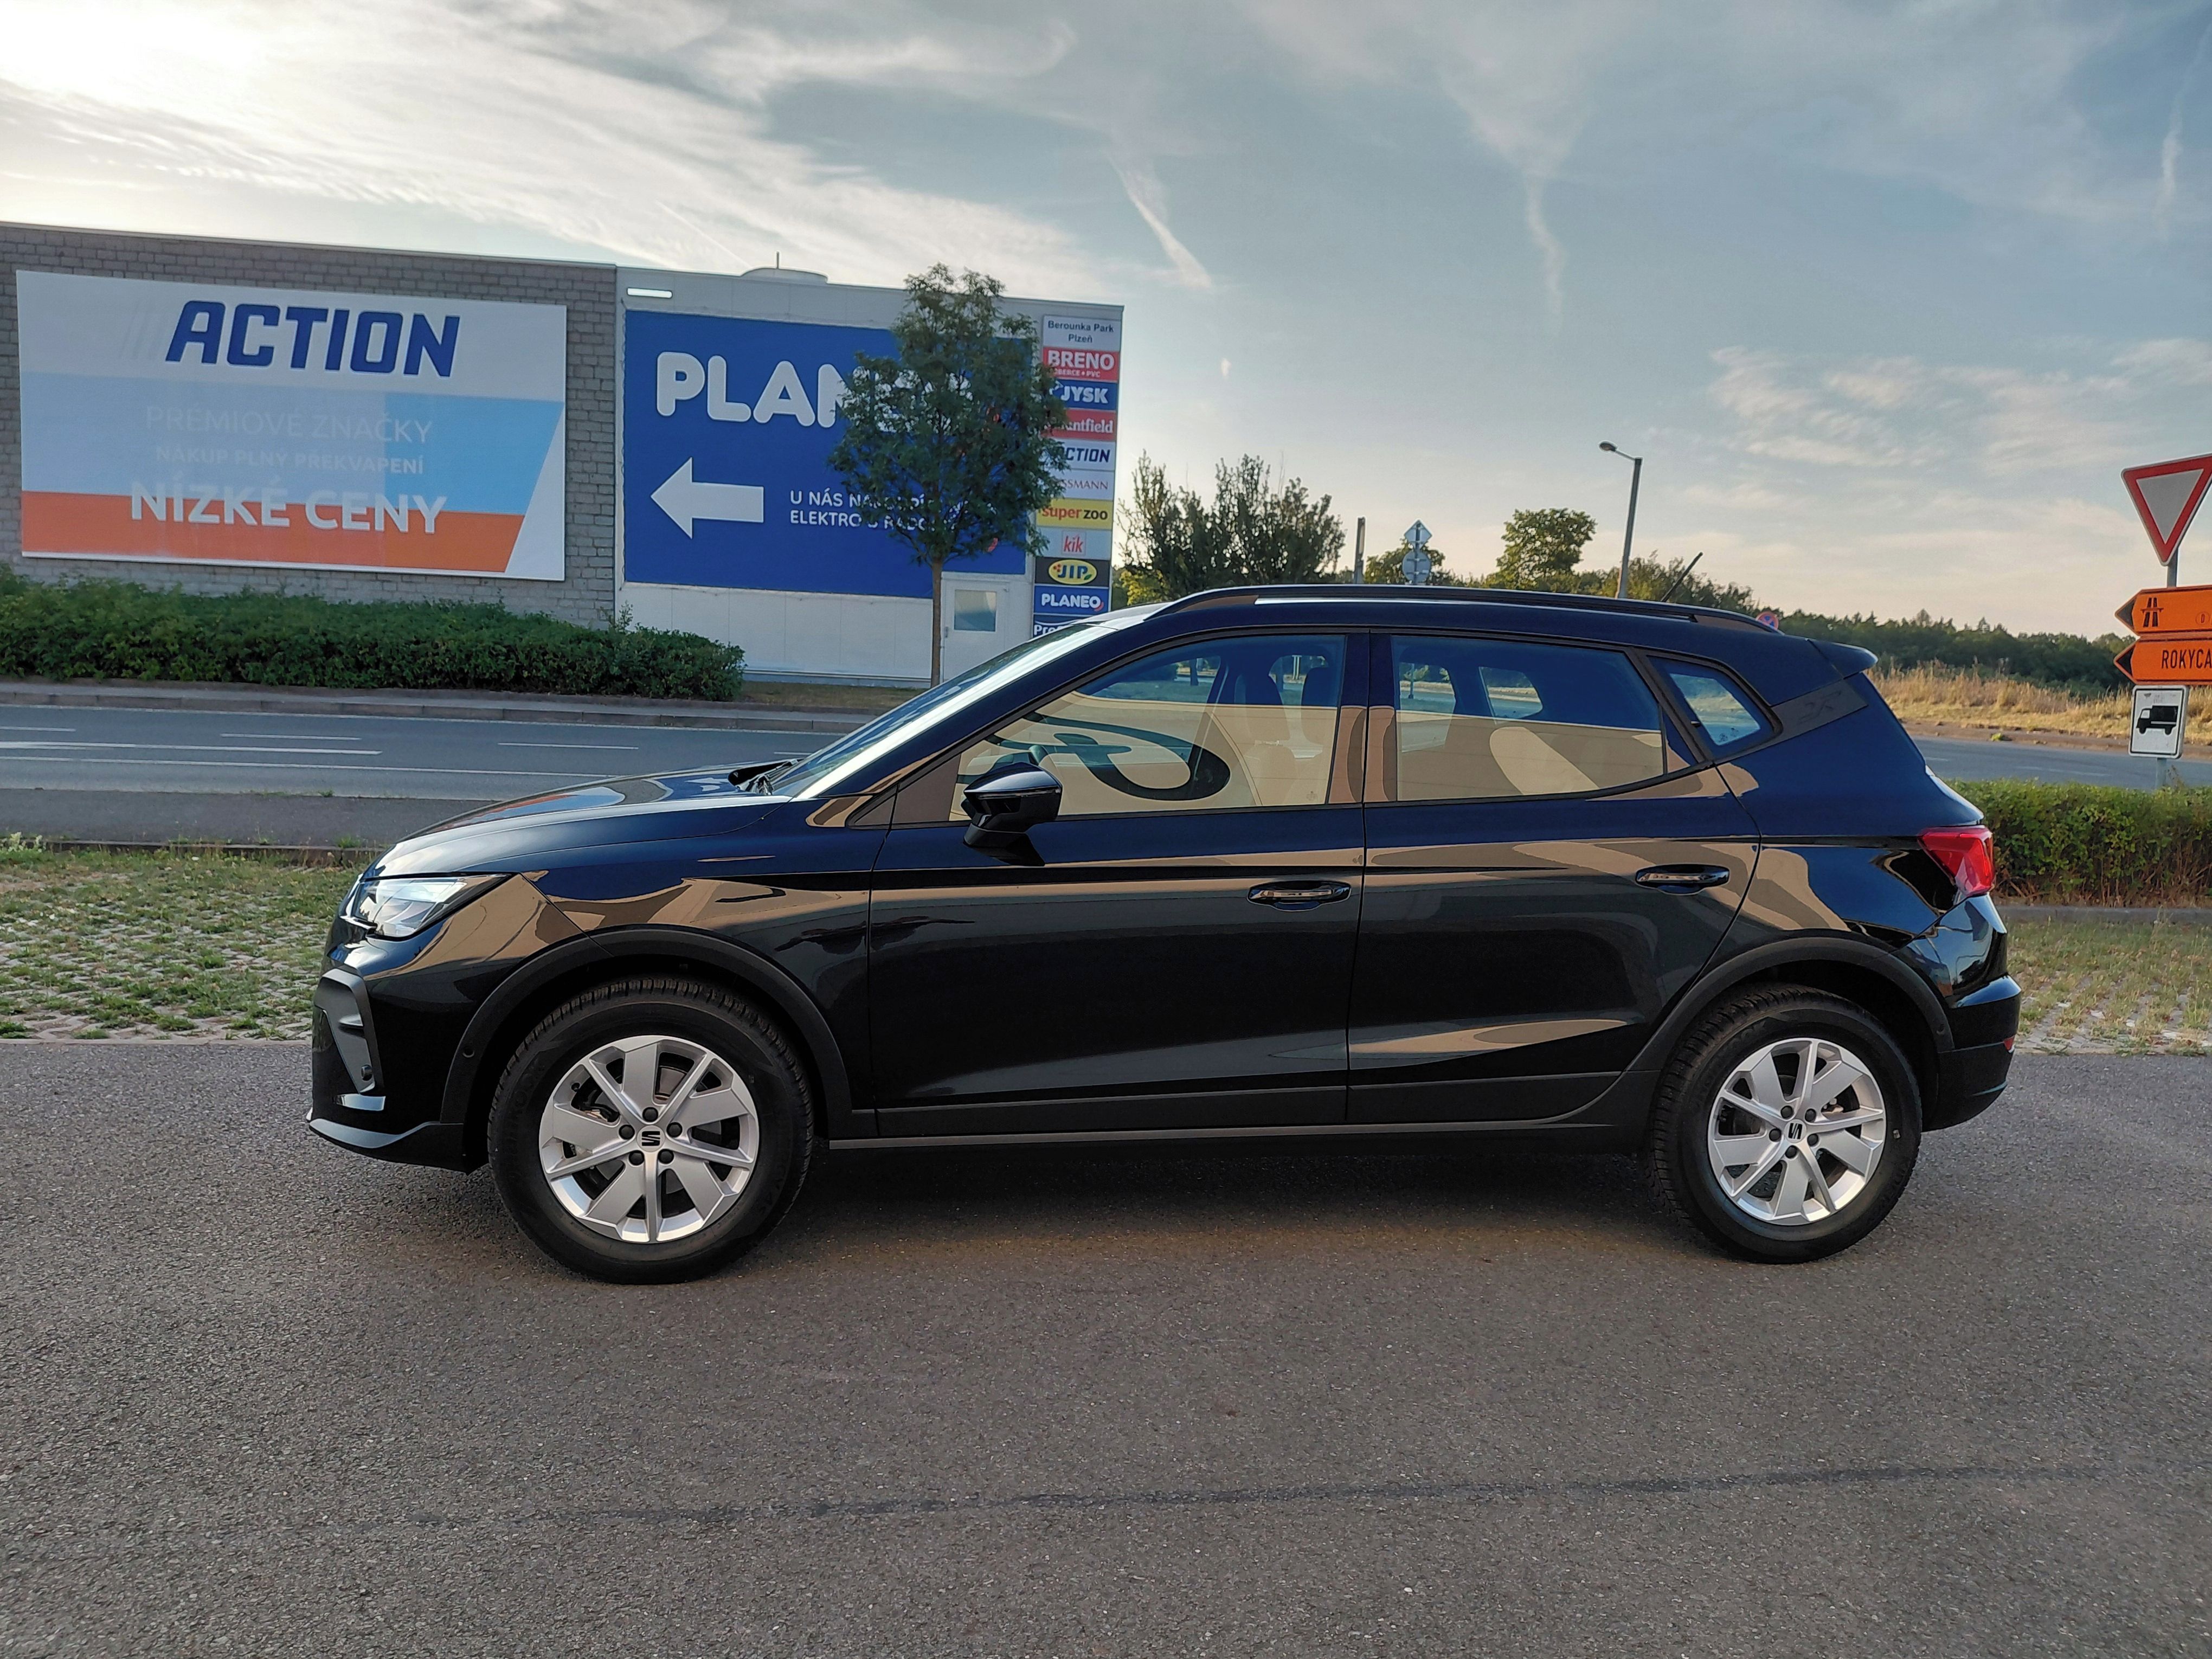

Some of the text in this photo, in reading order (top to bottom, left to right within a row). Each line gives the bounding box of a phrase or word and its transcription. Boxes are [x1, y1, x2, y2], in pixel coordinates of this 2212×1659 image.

[1047, 320, 1114, 333] Berounka Park
[165, 300, 460, 378] ACTION
[1048, 350, 1114, 370] BRENO
[1060, 385, 1108, 404] JYSK
[146, 403, 432, 443] PRÉMIOVÉ ZNAČKY
[1066, 447, 1110, 462] CTION
[131, 471, 447, 533] NÍZKÉ CENY
[790, 490, 802, 504] U
[808, 487, 843, 507] NÁS
[790, 510, 862, 527] ELEKTRO
[1042, 507, 1108, 520] super zoo
[1063, 535, 1083, 552] kik
[1057, 565, 1088, 578] JIP
[1041, 593, 1101, 608] PLANEO
[2161, 648, 2212, 668] ROKYCA
